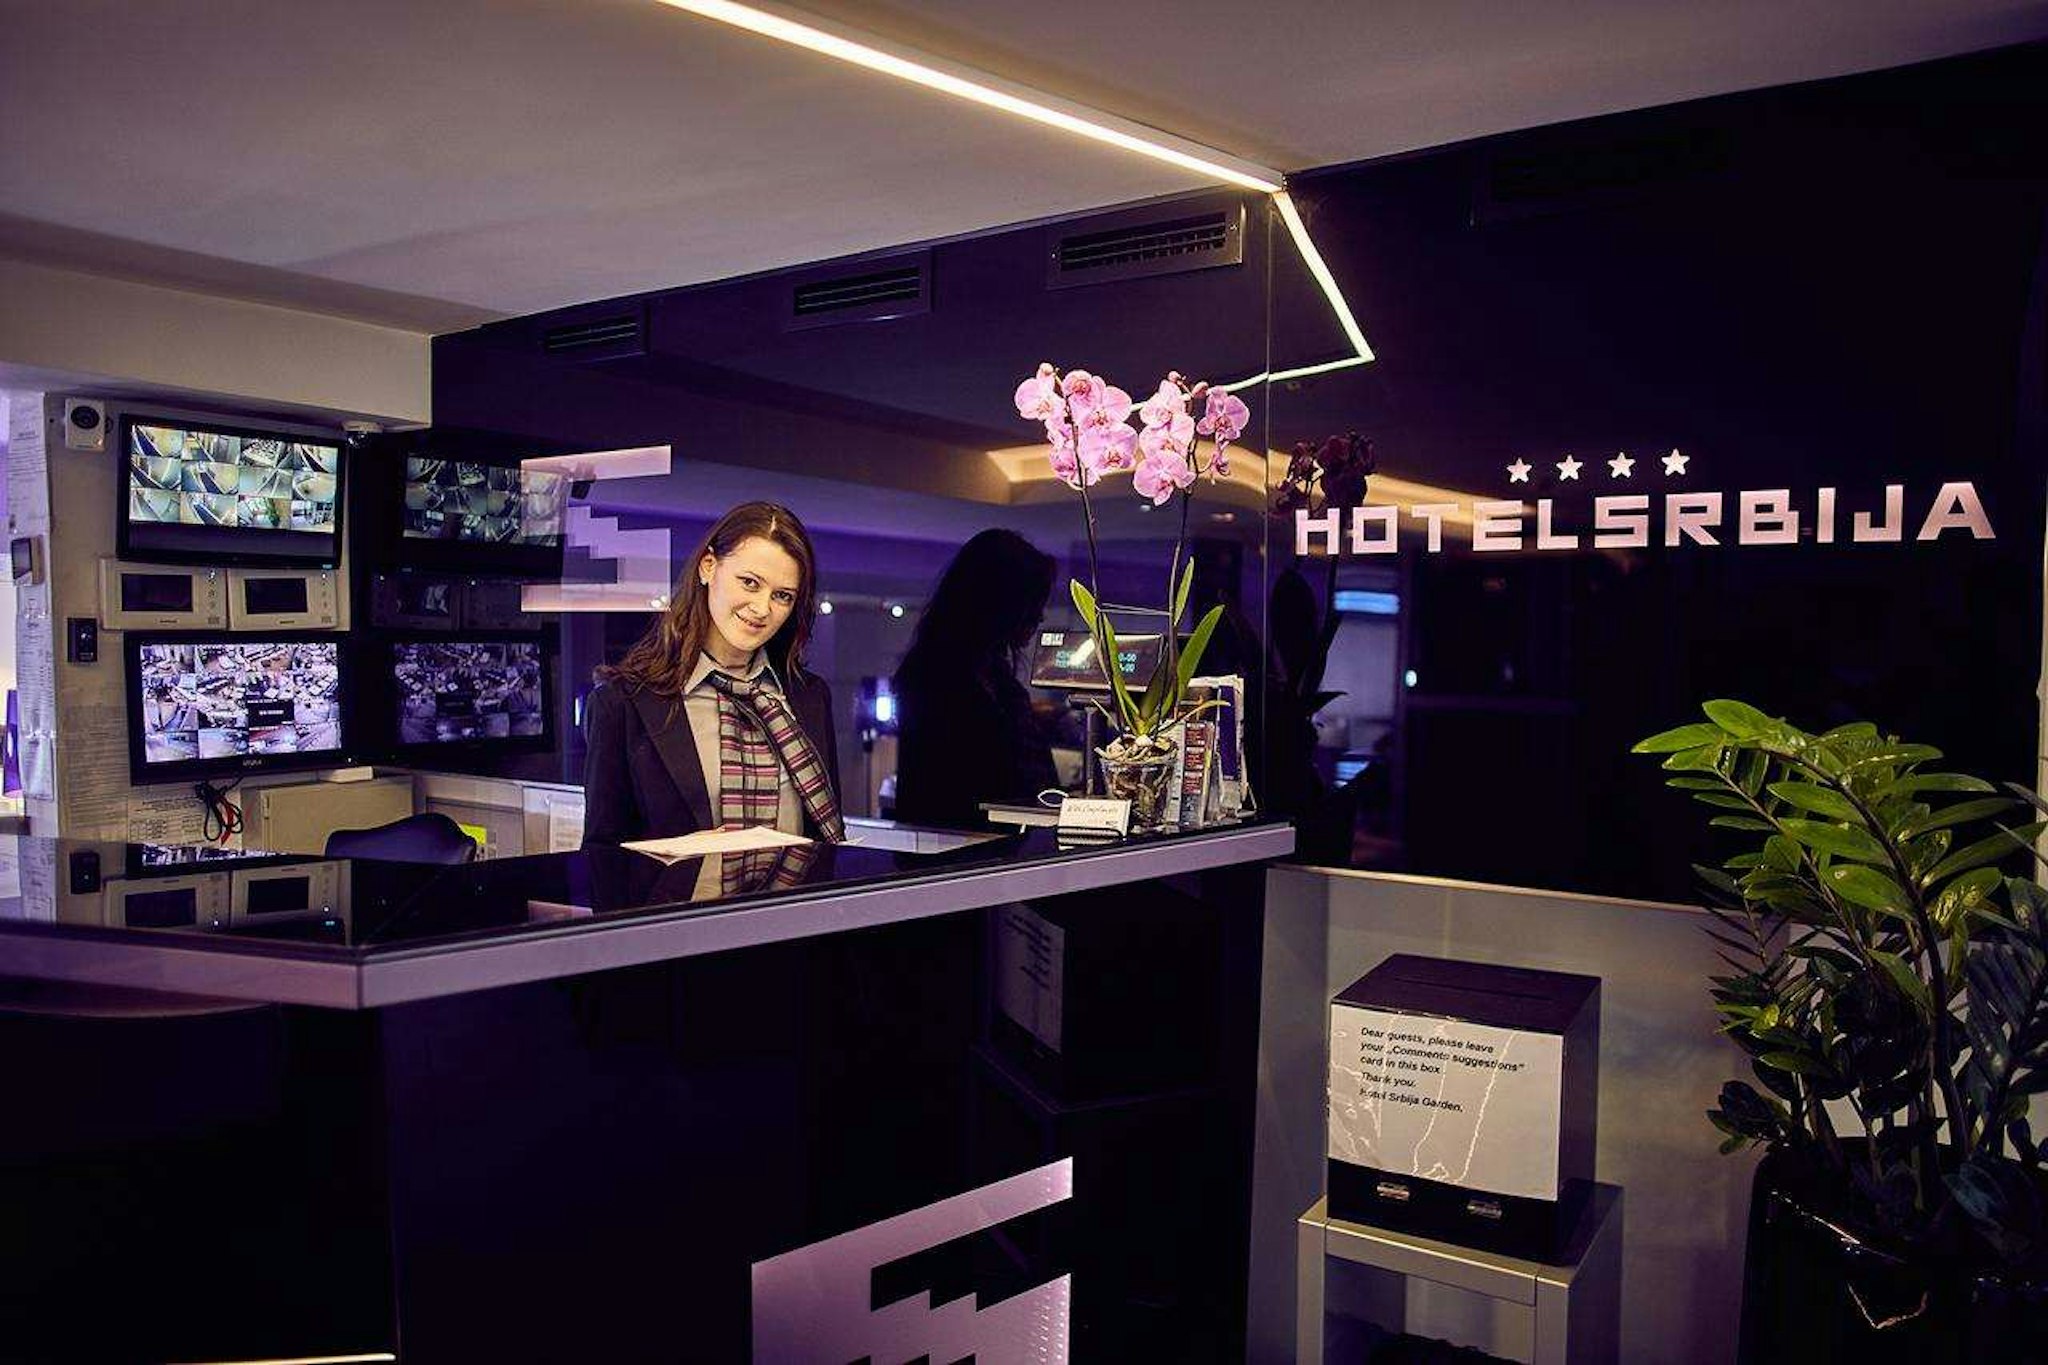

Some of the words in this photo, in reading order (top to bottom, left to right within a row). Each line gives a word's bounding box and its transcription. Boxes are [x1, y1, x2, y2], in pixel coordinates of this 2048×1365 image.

[1360, 1042, 1383, 1051] your
[1361, 1027, 1384, 1038] Dear
[1428, 1036, 1463, 1048] please
[1465, 1041, 1494, 1053] leave
[1360, 1056, 1383, 1066] card
[1385, 1058, 1395, 1068] in
[1398, 1060, 1418, 1071] this
[1420, 1062, 1440, 1074] box
[1362, 1071, 1391, 1084] Thank
[1388, 1092, 1419, 1106] Srbija
[1422, 1097, 1463, 1112] Garden.
